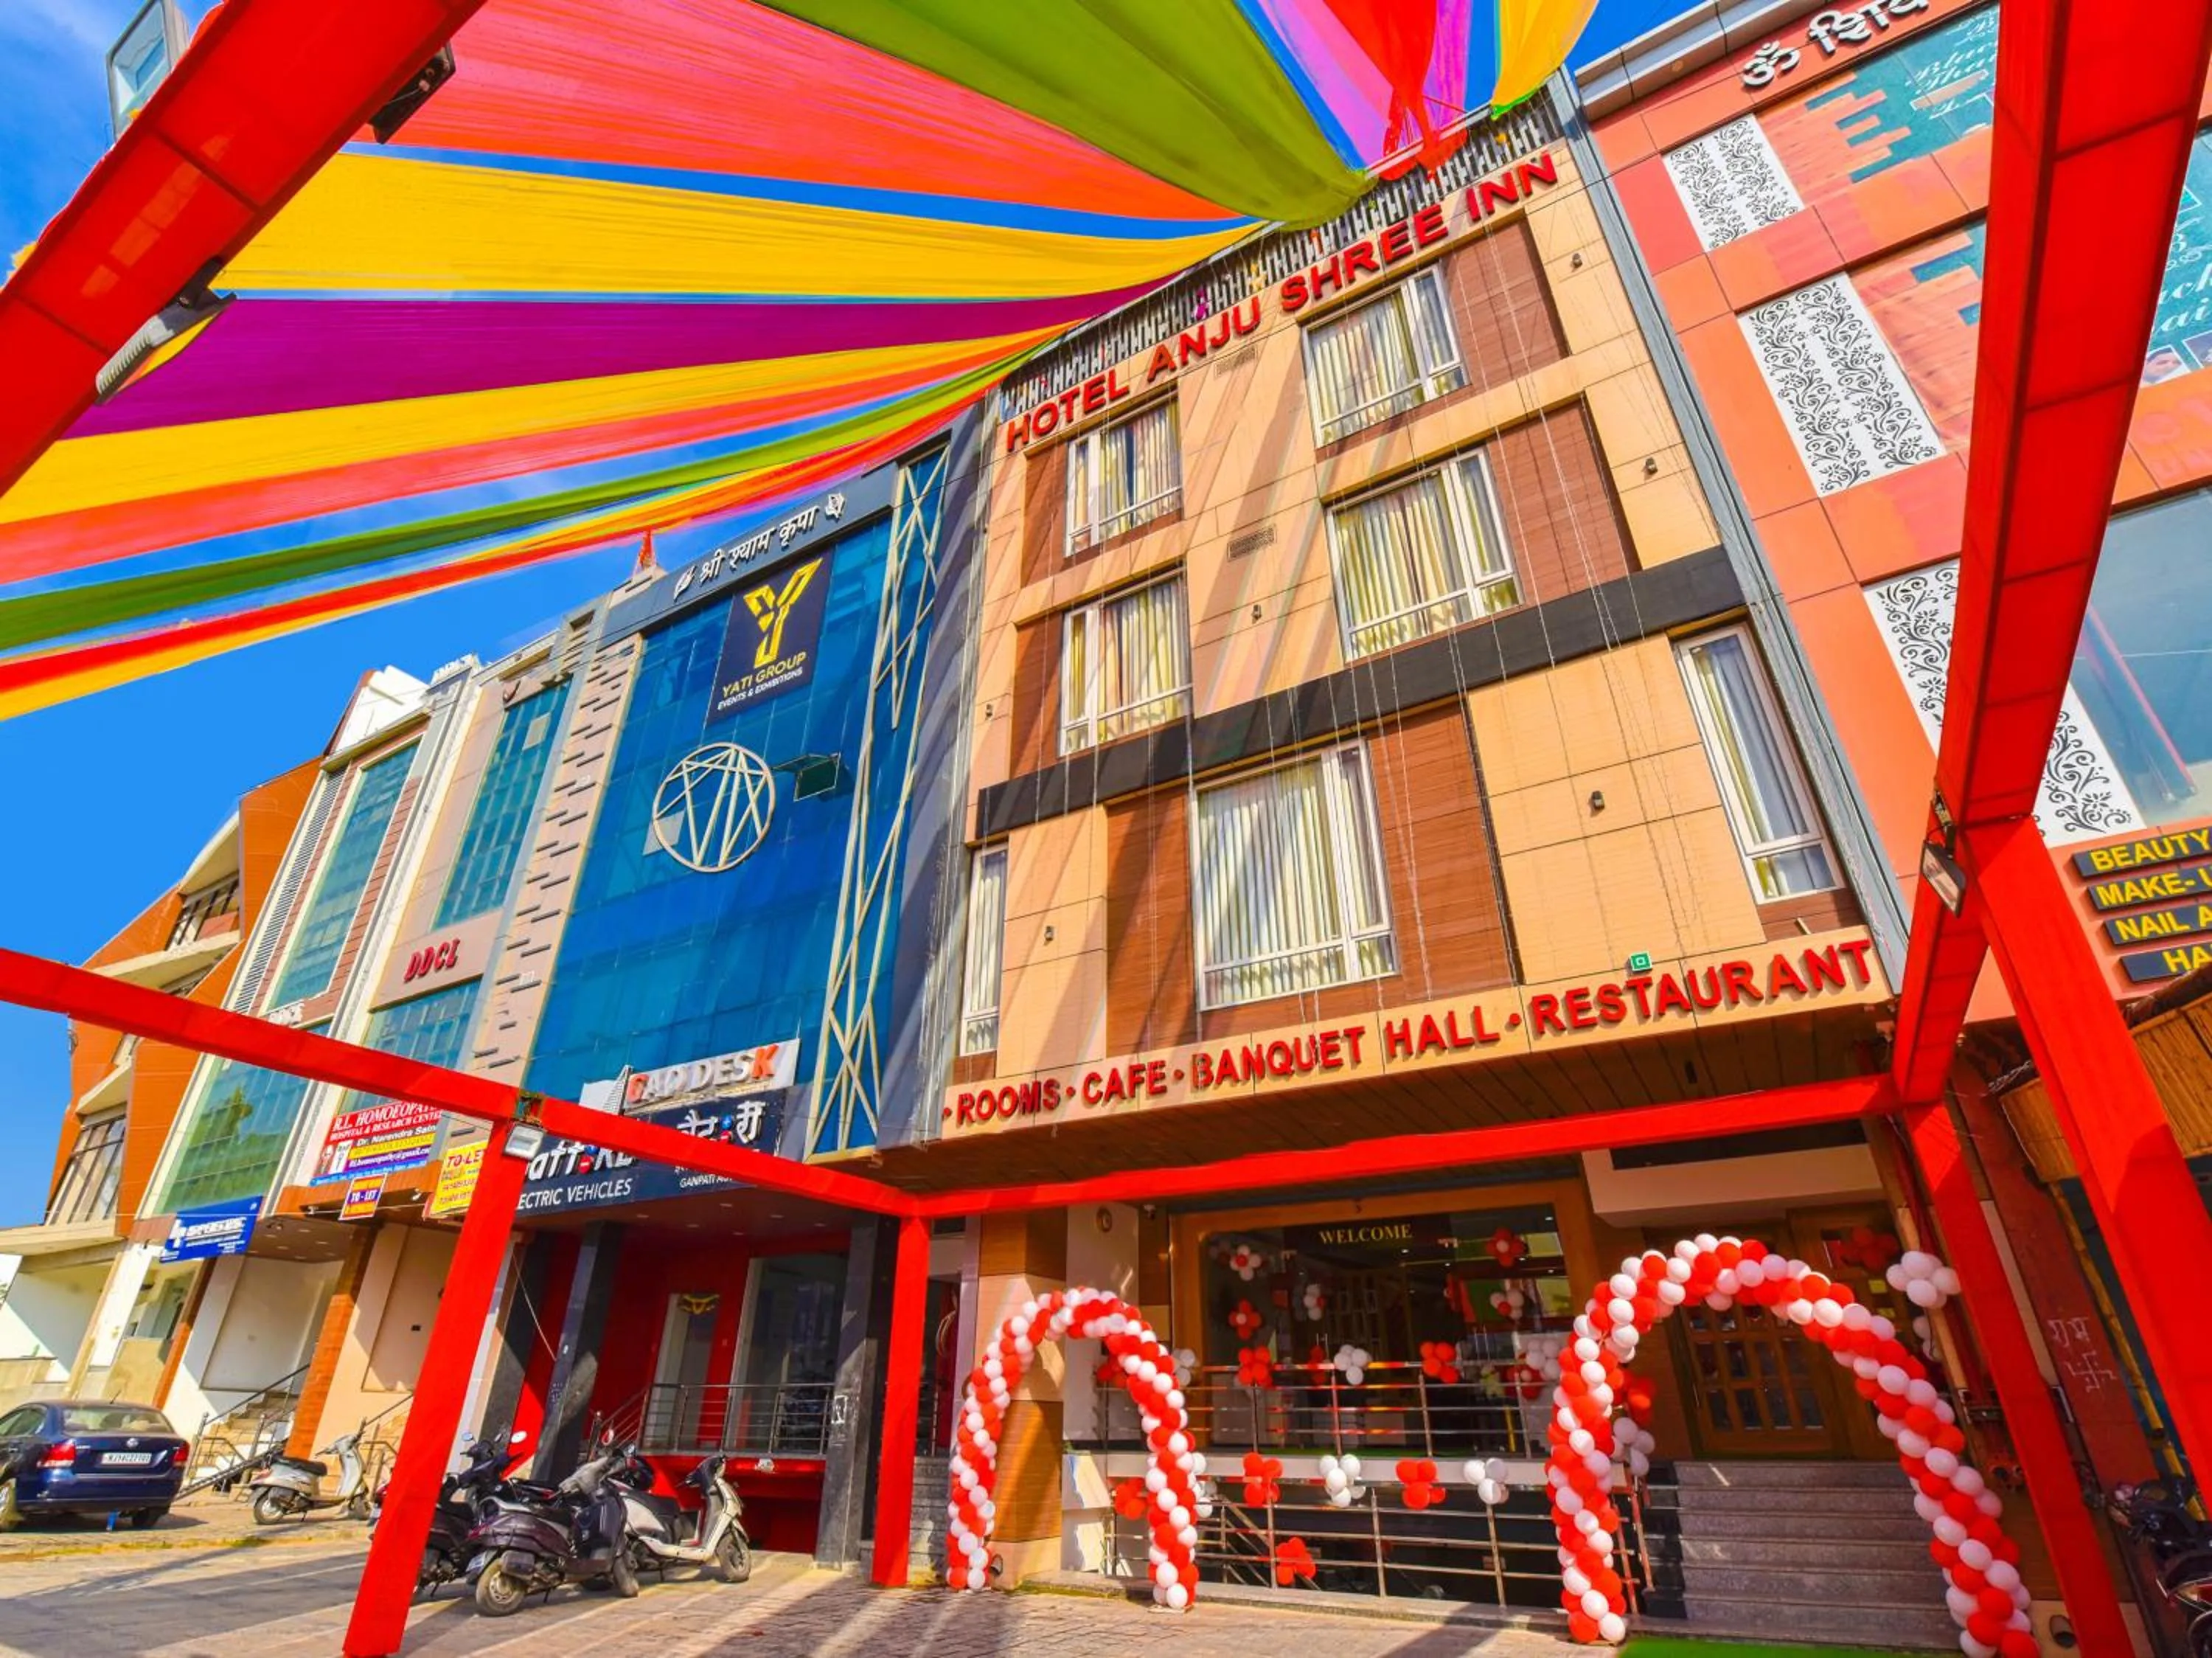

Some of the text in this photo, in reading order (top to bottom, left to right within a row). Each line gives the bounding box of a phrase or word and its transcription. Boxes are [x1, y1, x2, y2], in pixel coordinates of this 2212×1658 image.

[1006, 150, 1558, 452] HOTEL ANJU SHREE INN
[717, 666, 803, 710] EVENTS & EXHIBITIONS
[723, 651, 807, 698] YATI GROUP
[2090, 828, 2211, 872] BEAUTY
[2115, 911, 2191, 941] NAIL
[956, 938, 1872, 1125] ROOMS CAFE BANQUET HALL RESTAURANT
[627, 1044, 779, 1103] CAD DESK
[518, 1178, 633, 1210] ECTRIC VEHICLES
[1319, 1224, 1413, 1245] WELCOME
